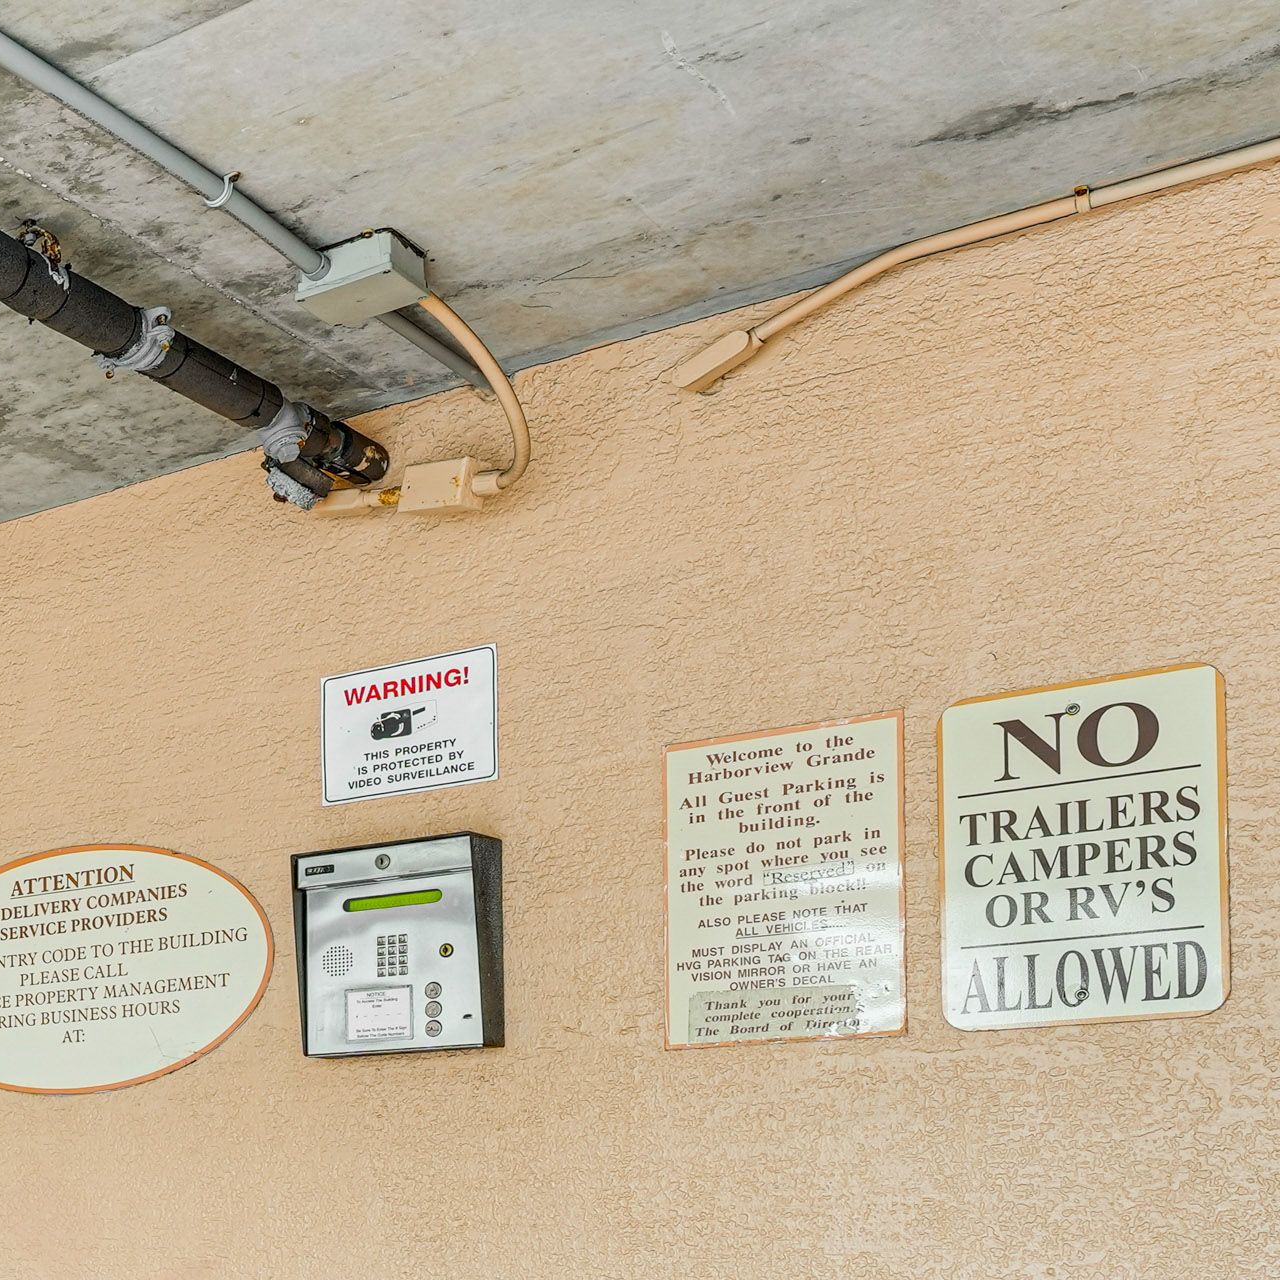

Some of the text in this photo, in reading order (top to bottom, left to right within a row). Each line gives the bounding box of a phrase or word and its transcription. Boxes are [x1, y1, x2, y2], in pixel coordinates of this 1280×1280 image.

[344, 666, 469, 706] WARNING!
[364, 738, 457, 762] THIS PROPERTY
[706, 735, 854, 767] Welcome to the
[993, 702, 1159, 782] NO
[348, 762, 475, 790] VIDEO SURVEILLANCE
[357, 750, 464, 775] IS PROTECTED BY
[688, 748, 875, 785] Harborview Grande
[679, 771, 885, 810] All Guest Parking is
[689, 790, 874, 824] in the front of the
[959, 785, 1201, 847] TRAILERS
[739, 815, 820, 834] building.
[685, 827, 881, 862] Please do not park in
[964, 830, 1198, 888] CAMPERS
[679, 845, 887, 879] any spot where you see
[680, 880, 705, 894] the
[715, 875, 753, 889] word
[866, 862, 886, 872] on
[11, 864, 135, 897] ATTENTION
[2, 898, 82, 922] DELIVERY
[87, 883, 188, 912] COMPANIES
[699, 894, 723, 907] the
[734, 887, 799, 906] parking
[985, 891, 1054, 928] OR
[1, 921, 67, 942] SERVICE
[71, 908, 168, 934] PROVIDERS
[698, 903, 868, 929] ALSO PLEASE NOTE THAT
[736, 926, 758, 938] ALL
[42, 947, 87, 965] CODE
[91, 944, 113, 960] TO
[118, 938, 153, 957] THE
[158, 927, 249, 952] BUILDING
[676, 943, 892, 972] HVG PARKING TAG ON THE REAR
[692, 932, 875, 959] MUST DISPLAY AN OFFICIAL
[20, 963, 129, 987] PLEASE CALL
[691, 958, 877, 982] VISION MIRROR OR HAVE AN
[730, 974, 835, 992] OWNER'S DECAL
[960, 940, 1208, 1015] ALLOWED
[15, 986, 98, 1008] PROPERTY
[103, 972, 230, 1000] MANAGEMENT
[704, 992, 854, 1011] Thank you for your
[41, 1006, 117, 1026] BUSINESS
[122, 999, 181, 1018] HOURS
[705, 1004, 854, 1024] complete cooperation.
[62, 1029, 85, 1044] AT:
[695, 1026, 720, 1037] The
[730, 1023, 769, 1035] Board
[779, 1021, 794, 1032] of
